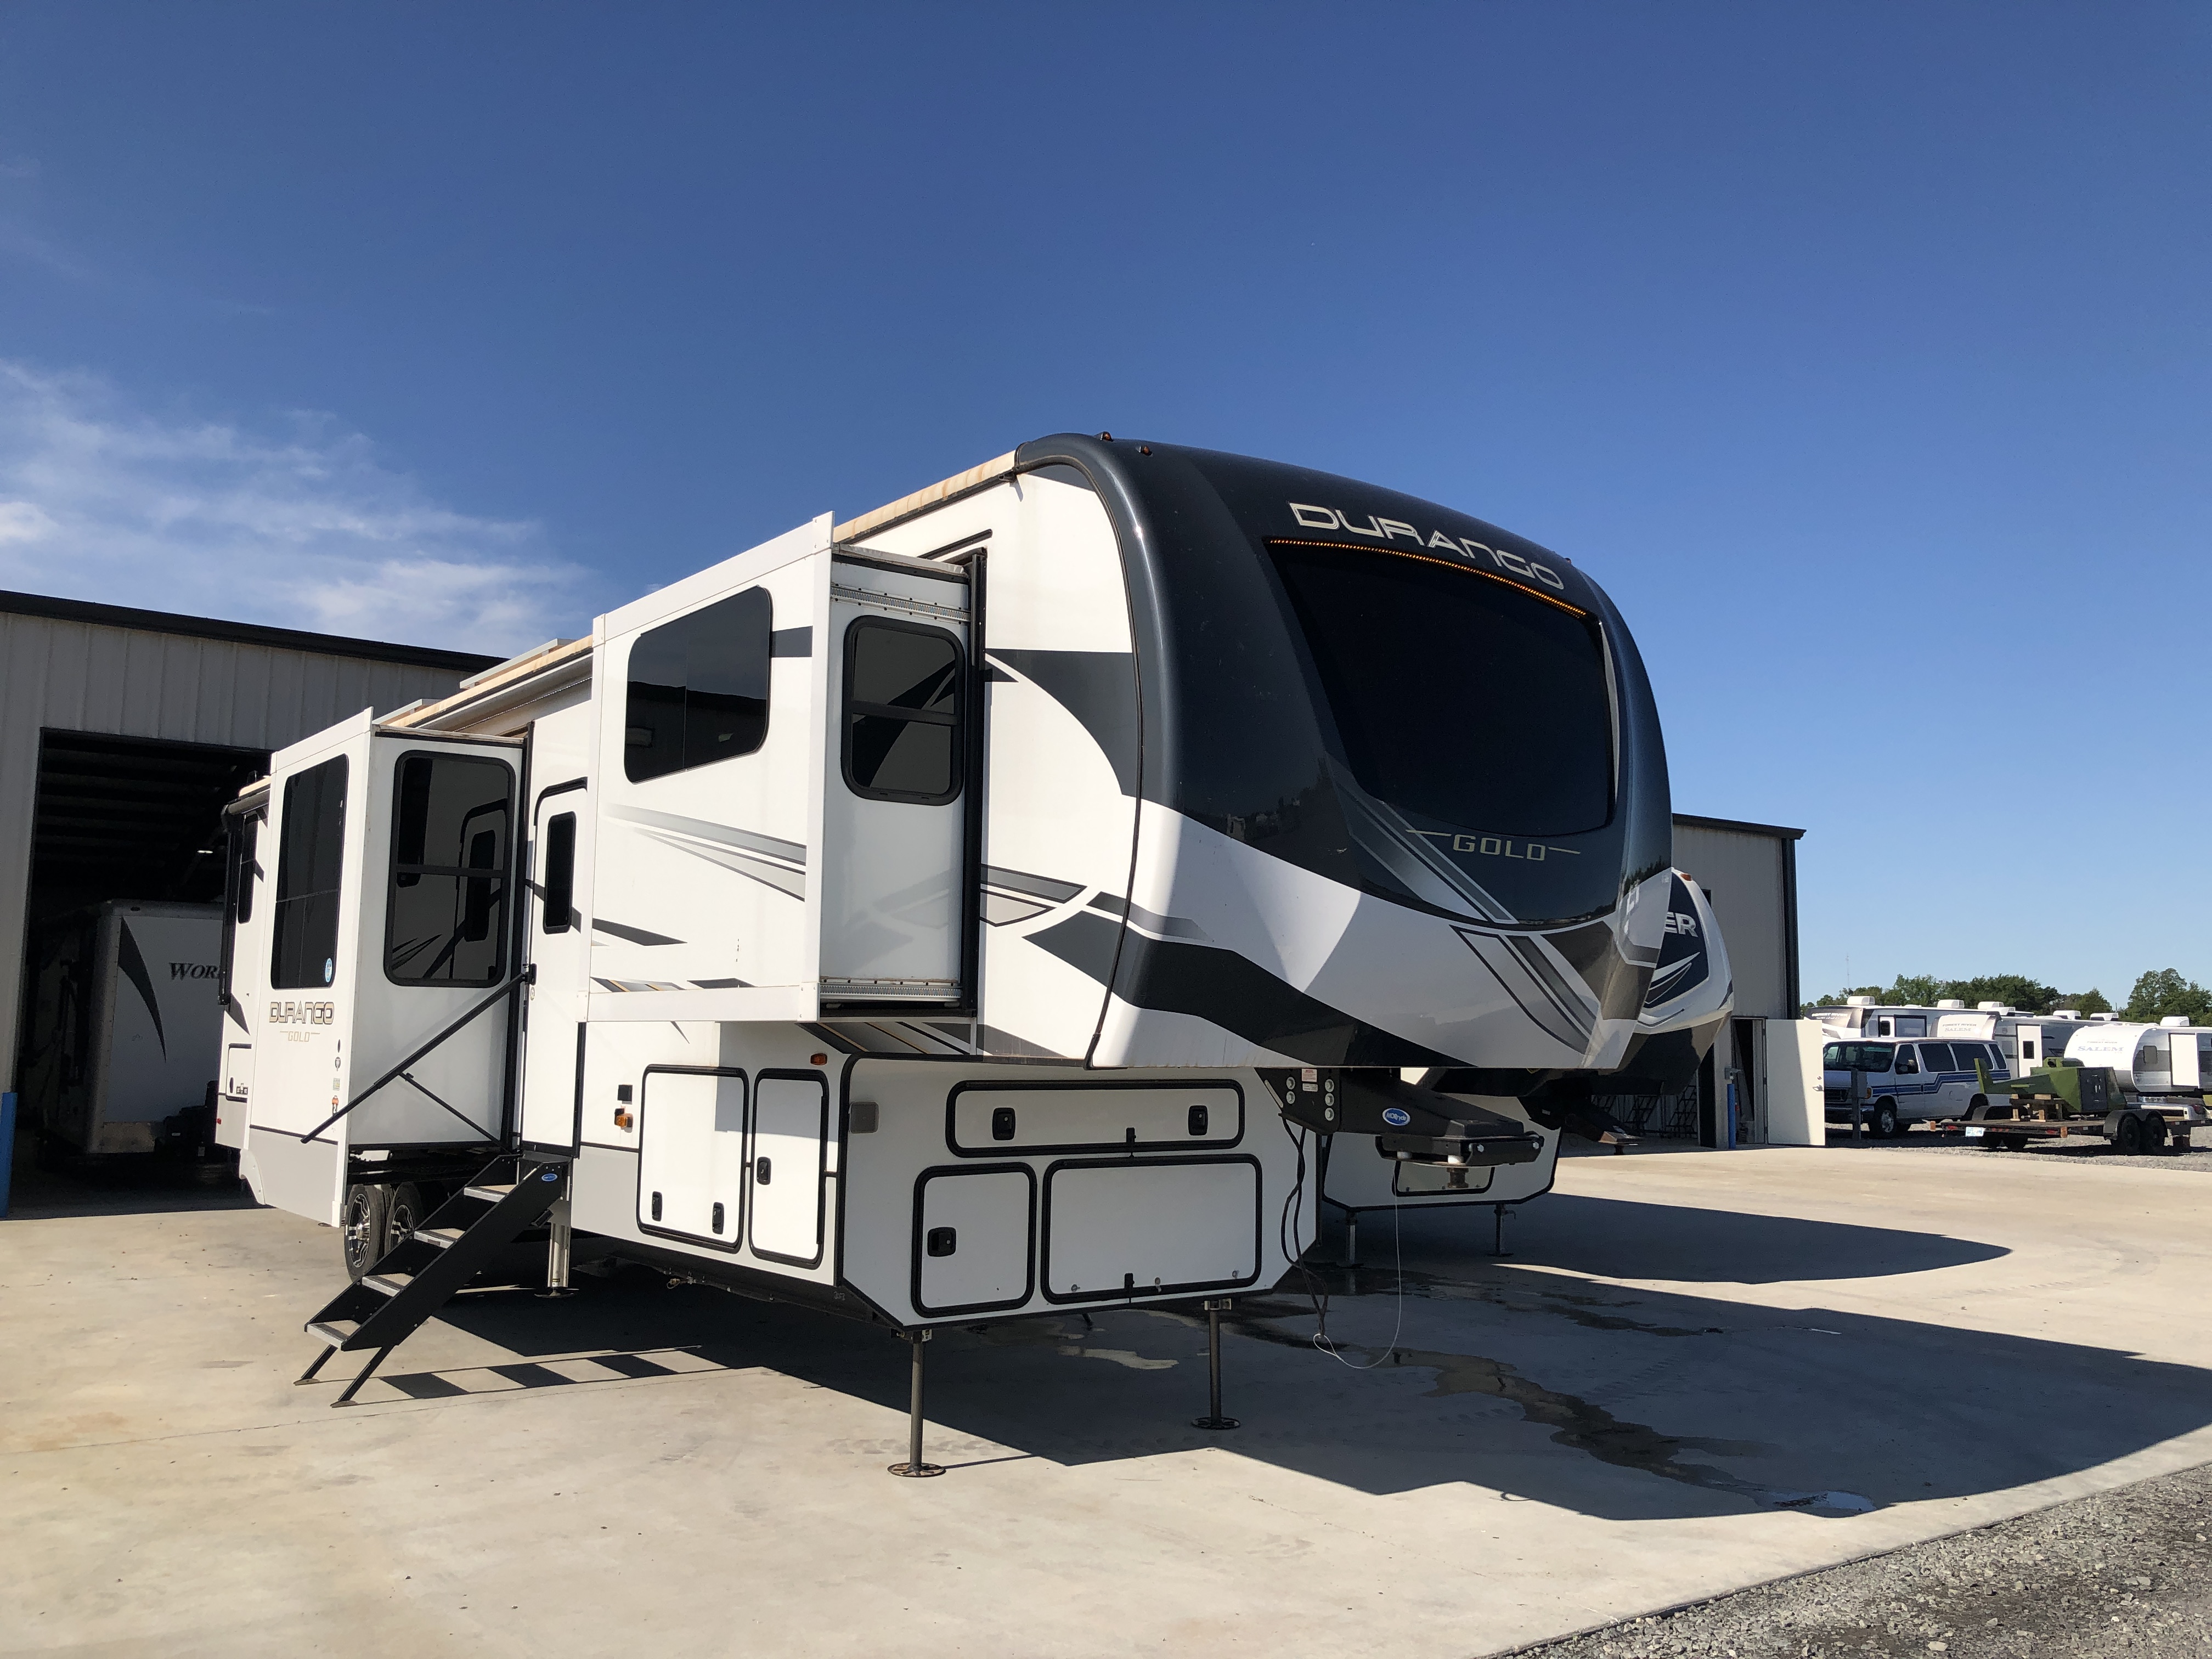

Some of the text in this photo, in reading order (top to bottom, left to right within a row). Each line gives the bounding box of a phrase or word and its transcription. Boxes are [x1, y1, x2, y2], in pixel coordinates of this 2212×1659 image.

[1289, 503, 1564, 589] DURANGO
[1453, 834, 1546, 861] GOLD
[169, 962, 219, 981] WOR
[269, 1001, 334, 1025] DURANGO
[288, 1031, 310, 1042] GOLD
